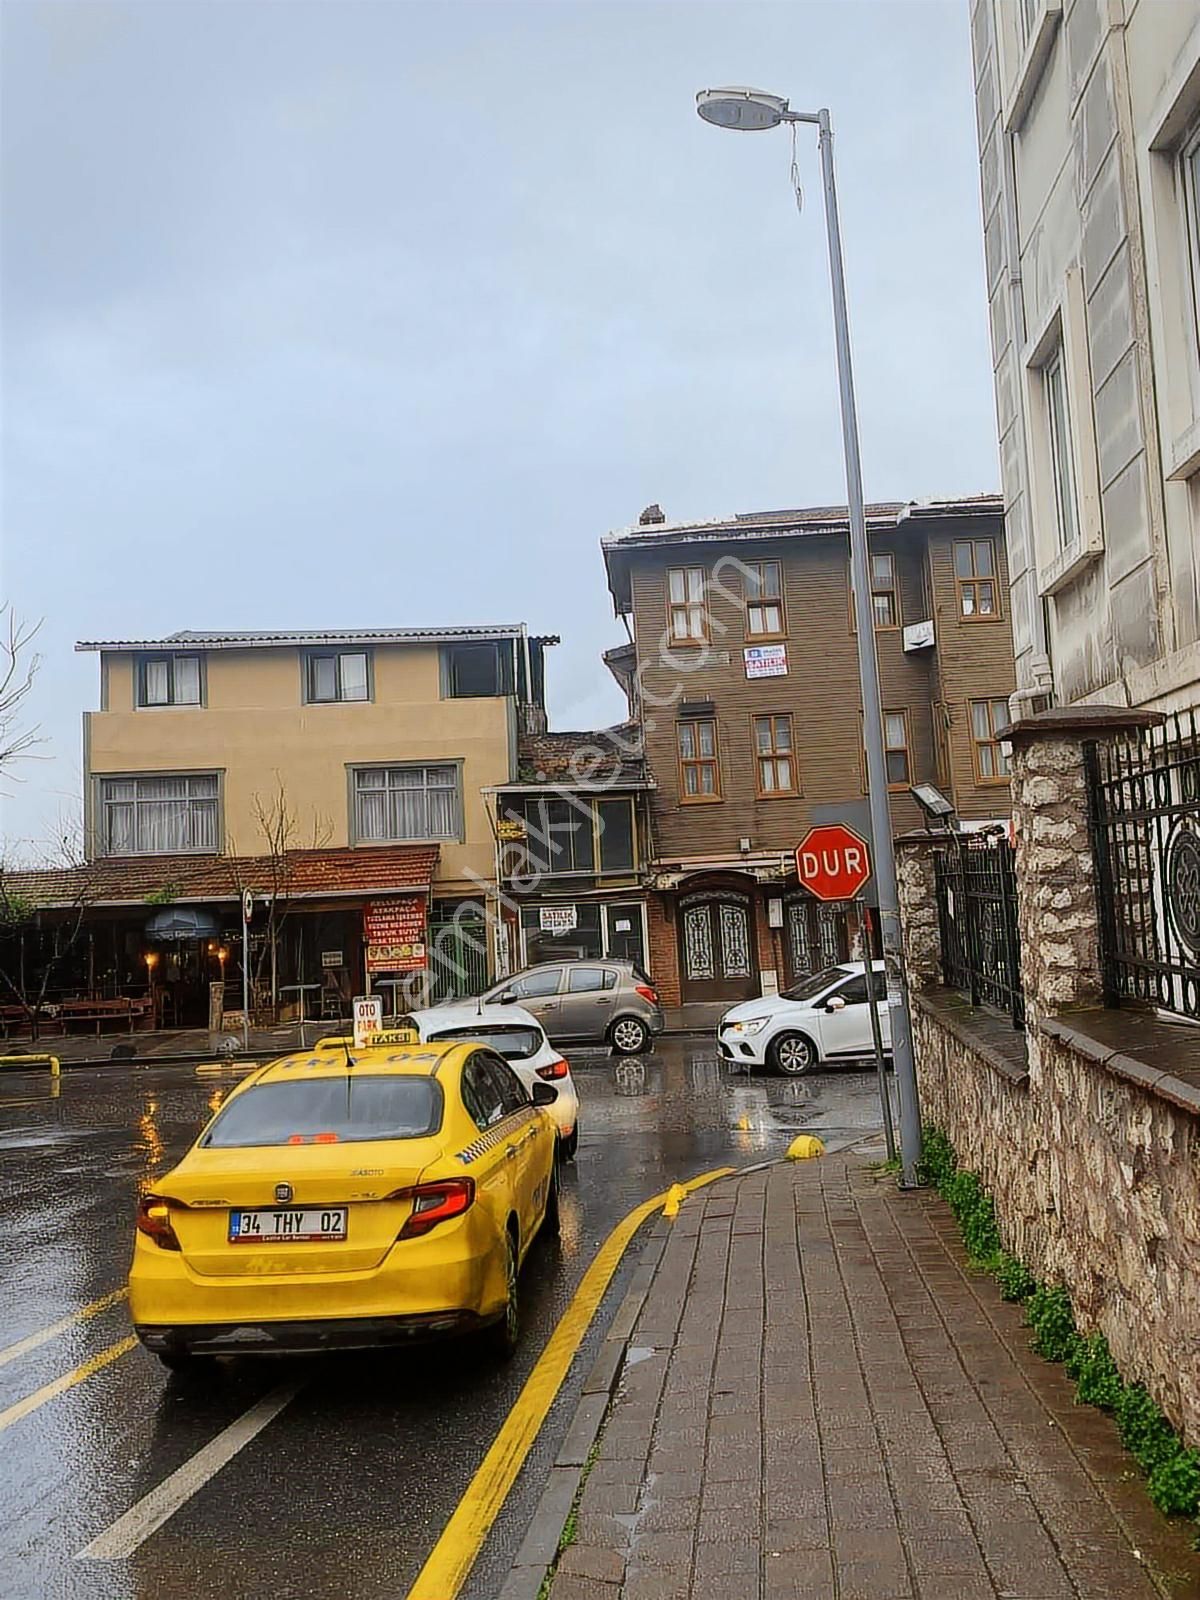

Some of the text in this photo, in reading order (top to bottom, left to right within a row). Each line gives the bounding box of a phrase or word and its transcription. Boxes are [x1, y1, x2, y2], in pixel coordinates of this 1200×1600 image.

[747, 656, 786, 669] SATILIK
[802, 847, 862, 878] DUR
[543, 911, 574, 919] SATILIK
[359, 1004, 376, 1016] OTO
[357, 1020, 379, 1033] PARK
[242, 1212, 342, 1234] 34 THY 02
